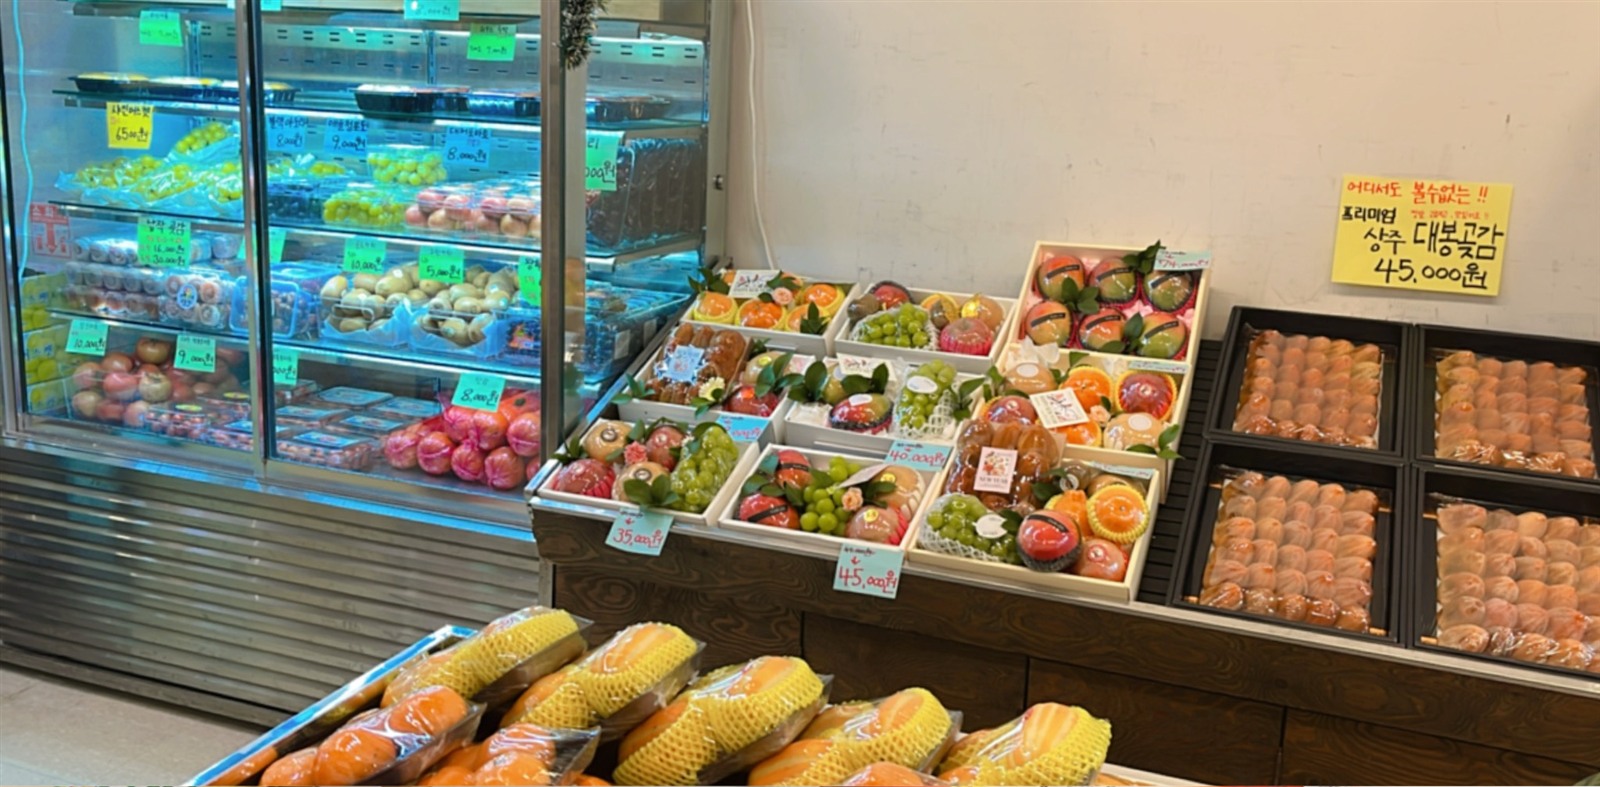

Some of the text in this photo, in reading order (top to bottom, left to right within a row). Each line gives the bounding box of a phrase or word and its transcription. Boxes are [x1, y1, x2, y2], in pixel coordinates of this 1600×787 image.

[1347, 181, 1403, 198] 어디서도
[1342, 205, 1397, 224] 프리미엄
[1363, 220, 1505, 261] 상주 대봉곶감
